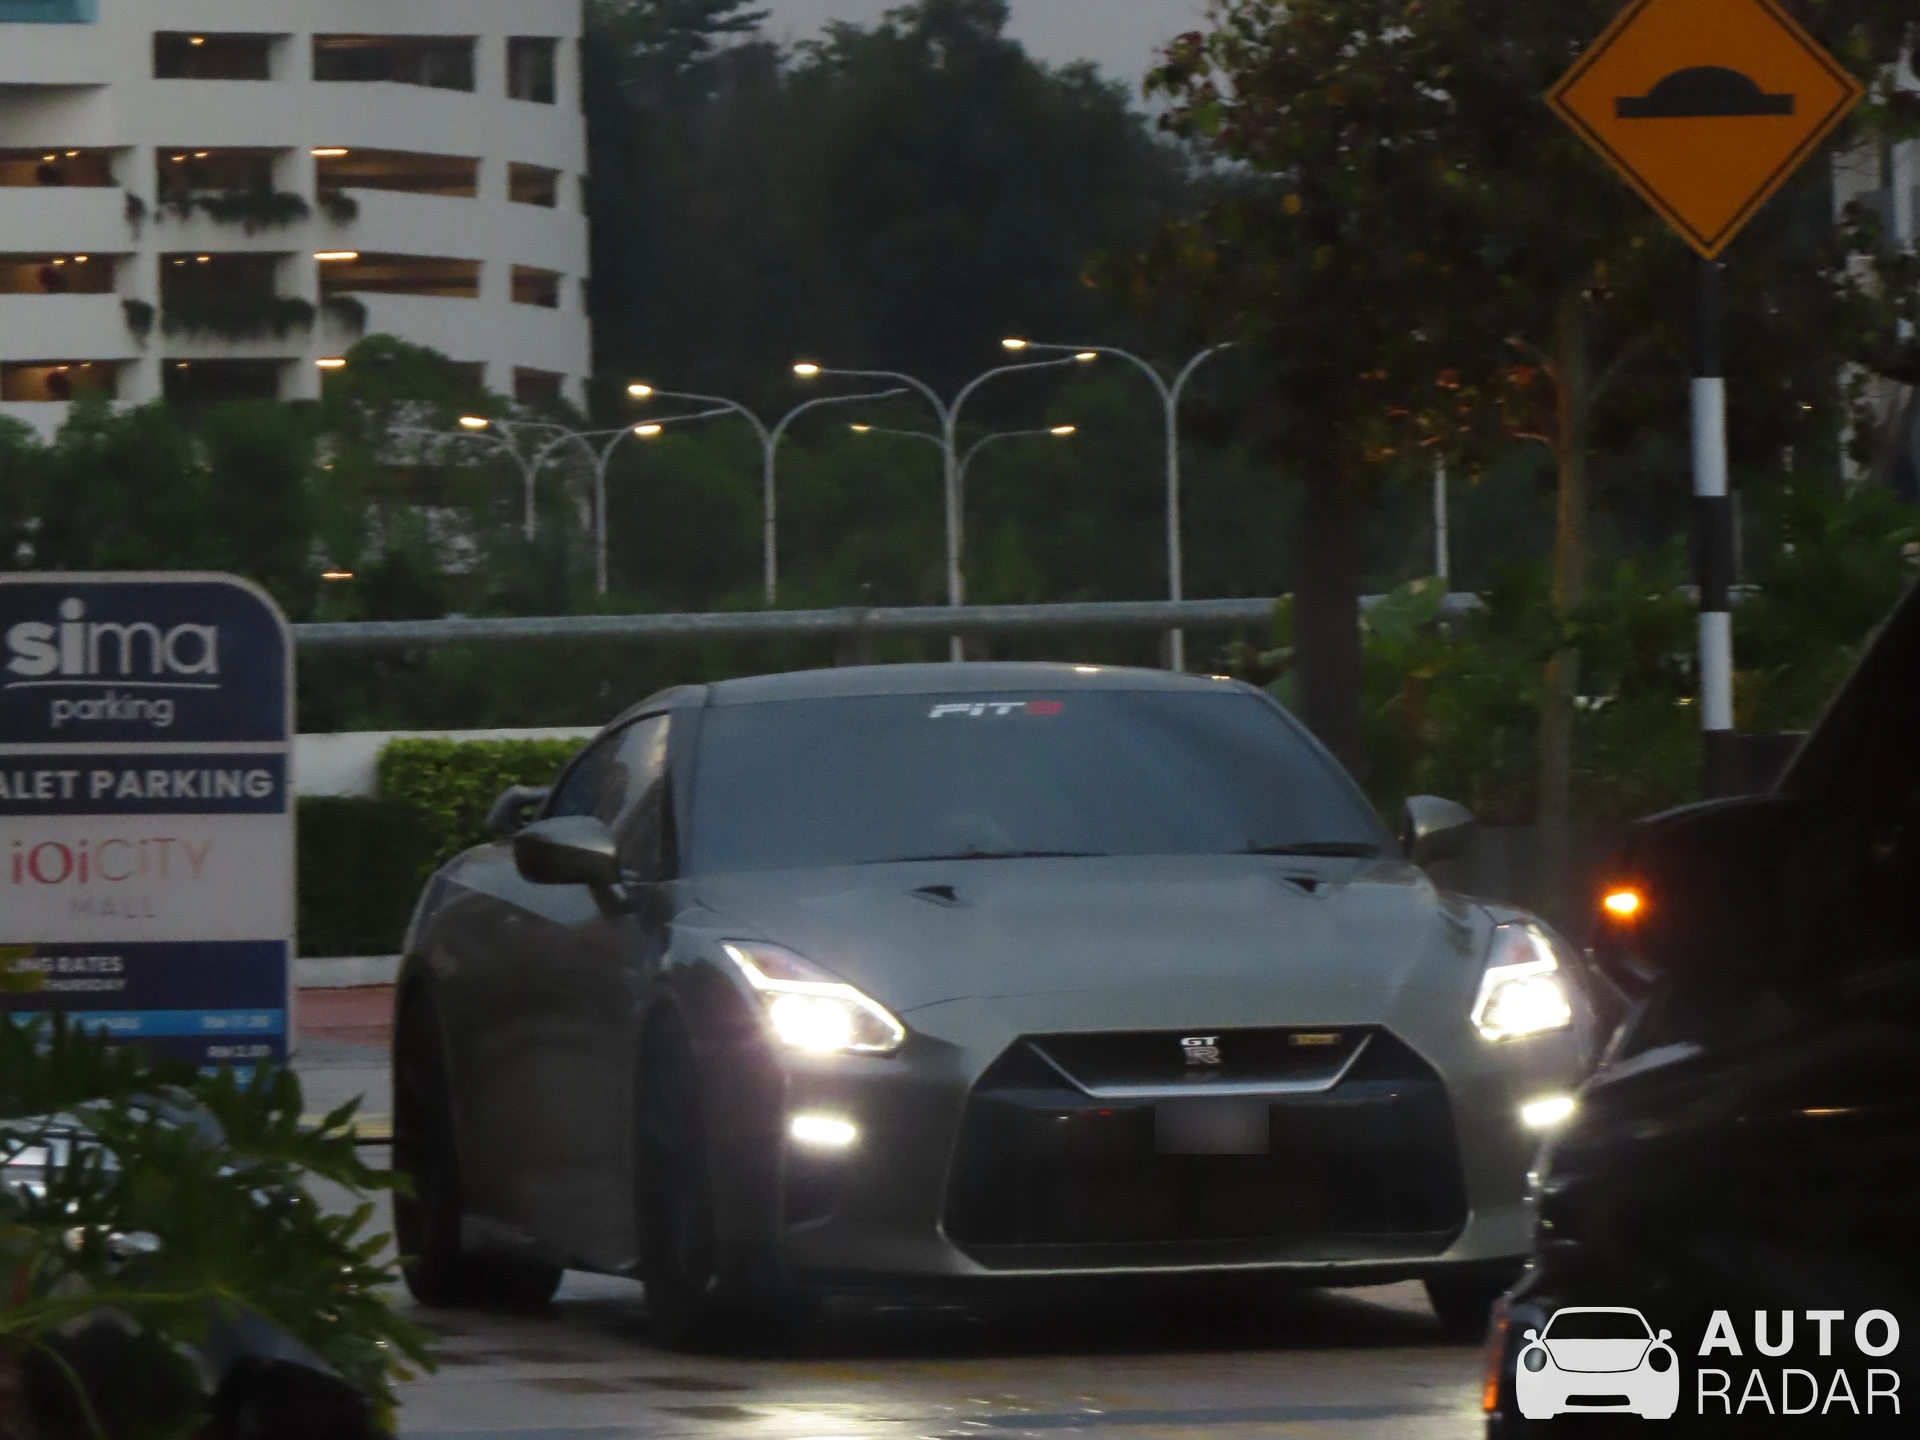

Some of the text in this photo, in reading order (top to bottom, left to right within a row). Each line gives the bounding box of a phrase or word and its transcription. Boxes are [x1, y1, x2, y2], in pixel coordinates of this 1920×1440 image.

[5, 597, 220, 676] sima
[51, 690, 175, 728] parking
[89, 769, 274, 799] PARKING
